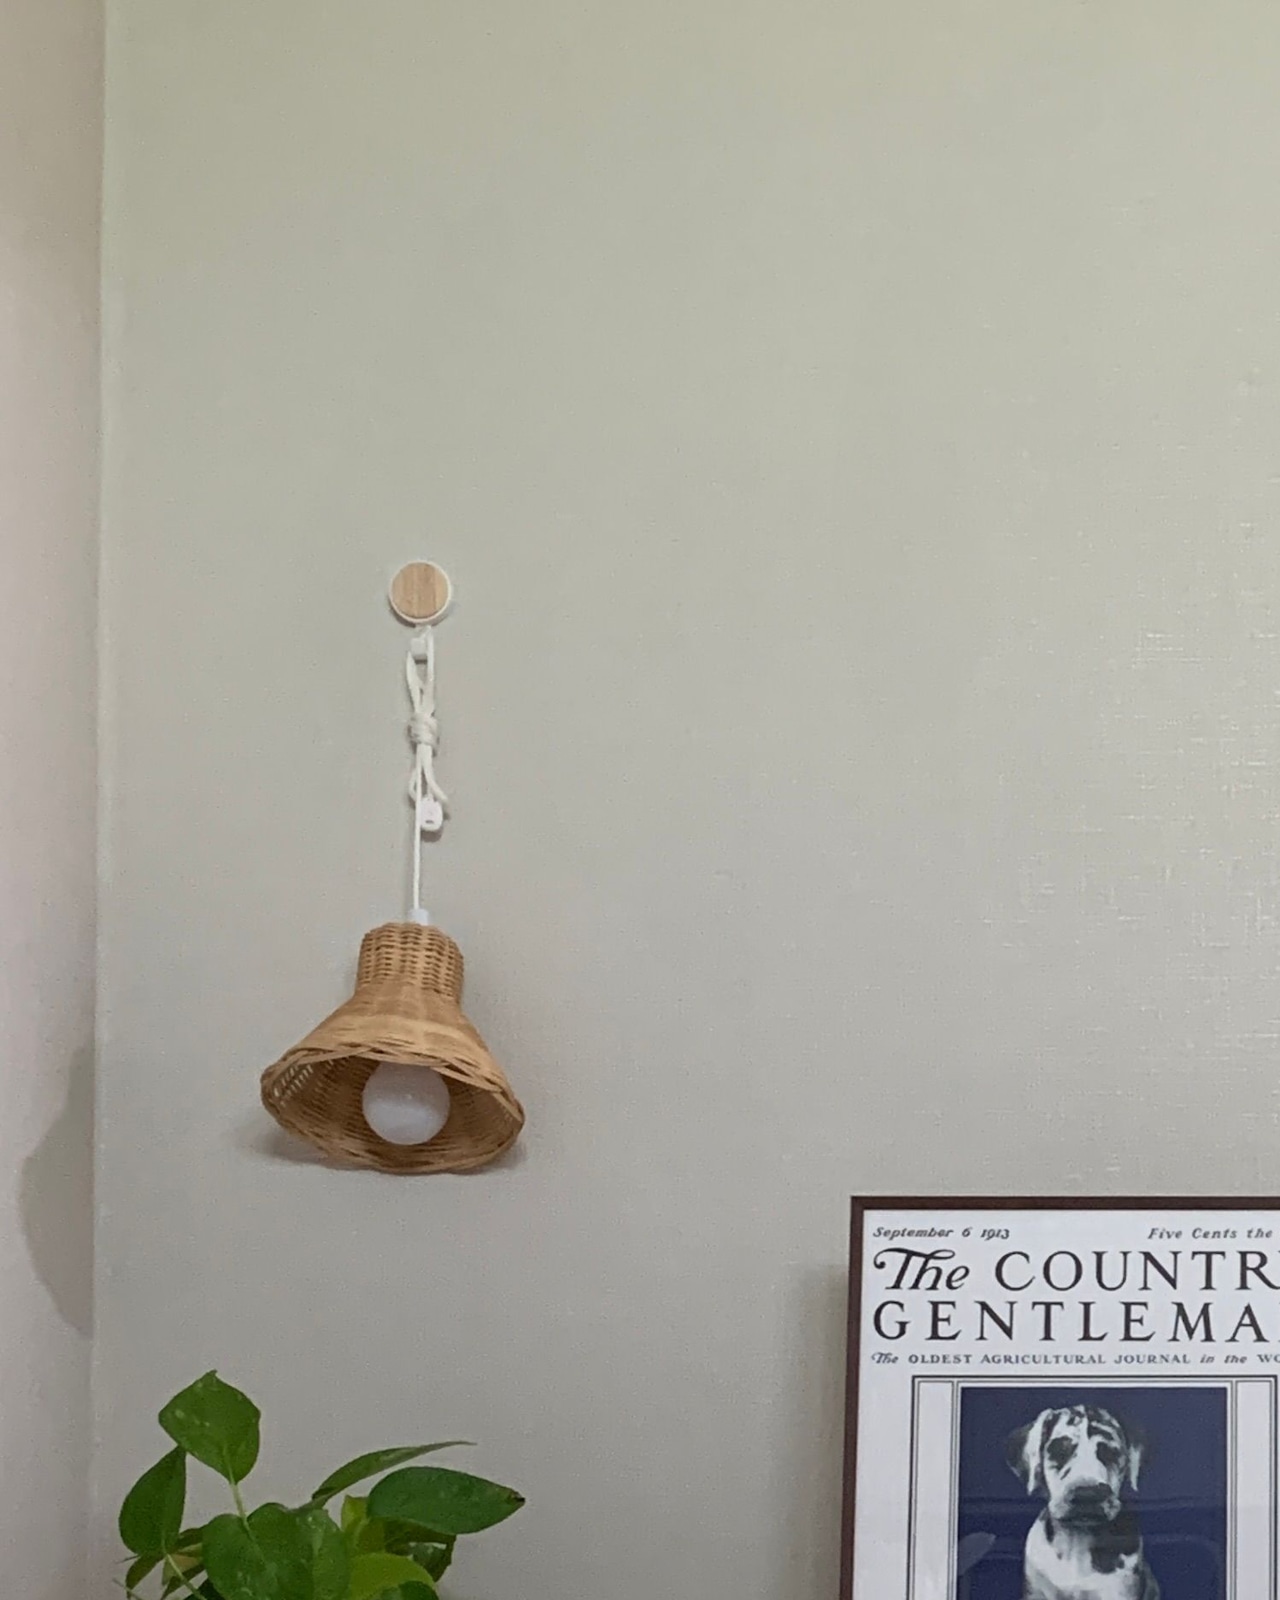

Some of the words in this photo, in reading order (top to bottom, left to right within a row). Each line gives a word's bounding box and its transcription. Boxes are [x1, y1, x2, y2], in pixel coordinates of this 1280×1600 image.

[872, 1226, 954, 1241] September
[961, 1226, 973, 1238] 6
[980, 1228, 1010, 1241] 1913
[1147, 1227, 1183, 1240] Five
[1191, 1227, 1238, 1240] Cents
[1246, 1227, 1273, 1239] the
[873, 1247, 970, 1291] The
[871, 1352, 899, 1365] The
[908, 1354, 973, 1364] OLDEST
[980, 1354, 1105, 1365] AGRICULTURAL
[1114, 1353, 1191, 1365] JOURNAL
[1200, 1353, 1215, 1364] in
[1224, 1353, 1247, 1364] the
